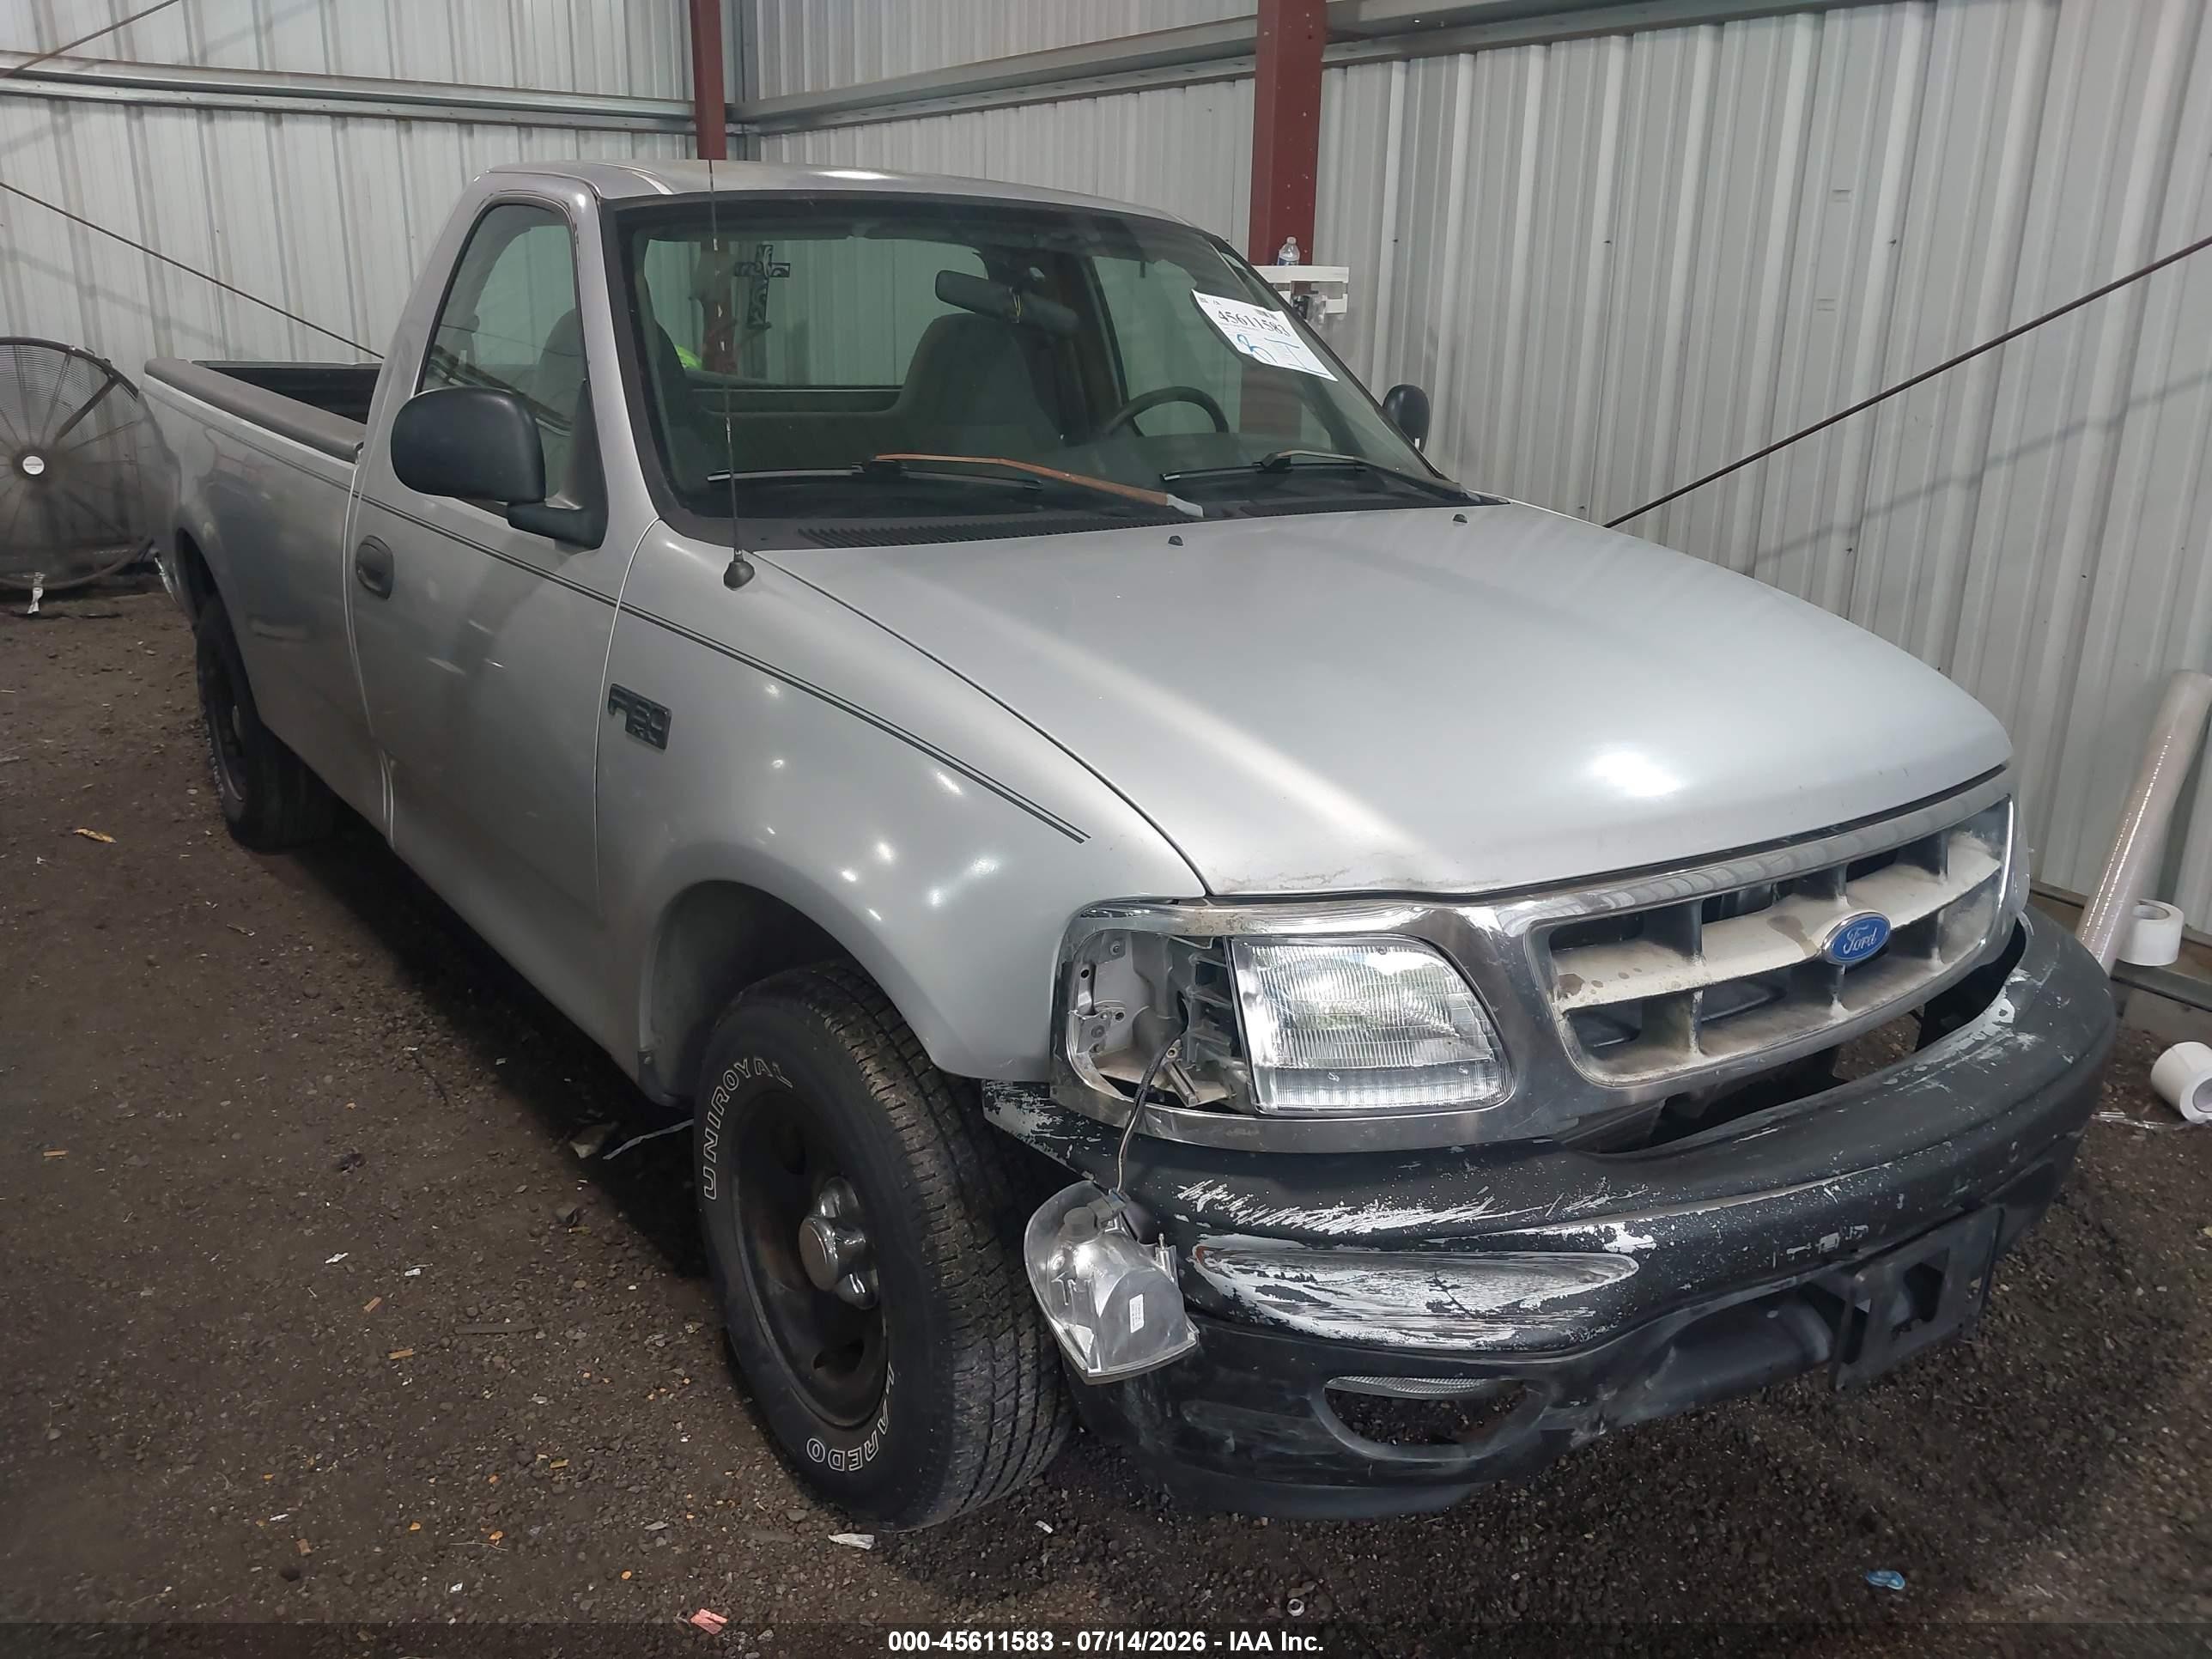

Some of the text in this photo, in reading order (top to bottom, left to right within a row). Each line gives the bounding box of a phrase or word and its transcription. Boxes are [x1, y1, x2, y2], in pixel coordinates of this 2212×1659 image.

[1218, 310, 1291, 337] 45611583
[1843, 925, 1877, 954] Ford
[702, 1056, 793, 1200] UNIROYAL
[806, 1360, 895, 1471] LAREDO
